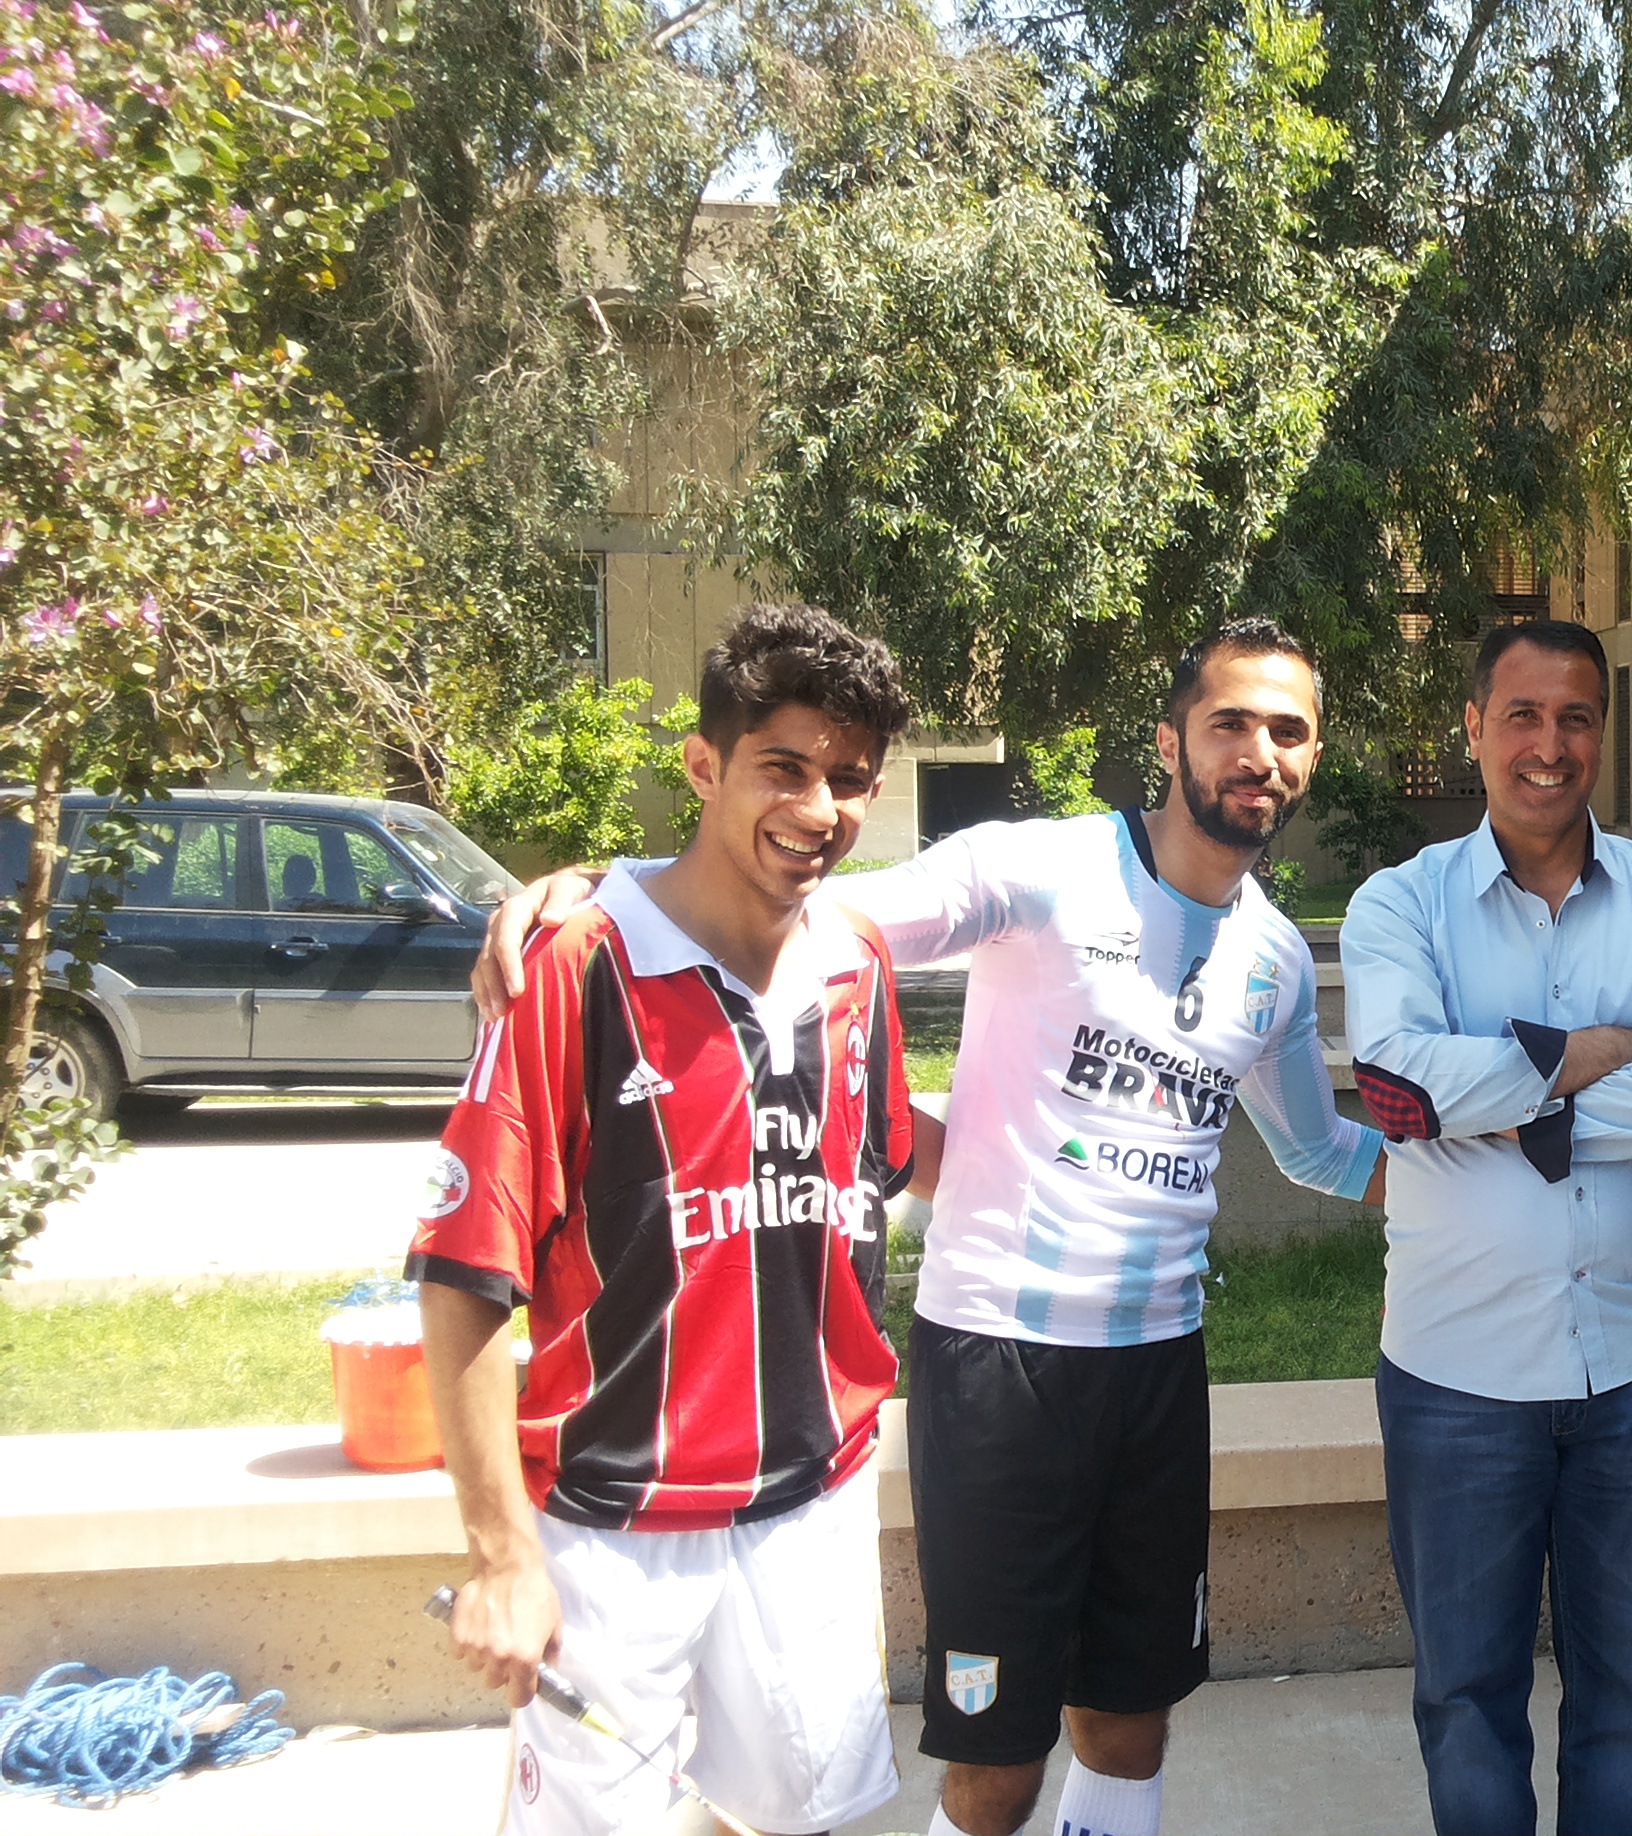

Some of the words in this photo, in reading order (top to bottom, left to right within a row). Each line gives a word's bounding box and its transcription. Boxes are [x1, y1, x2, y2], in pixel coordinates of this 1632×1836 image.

[1085, 946, 1141, 966] Topper
[1174, 955, 1208, 1032] 6
[1060, 1049, 1232, 1129] BRAVA
[755, 1105, 818, 1160] Fly
